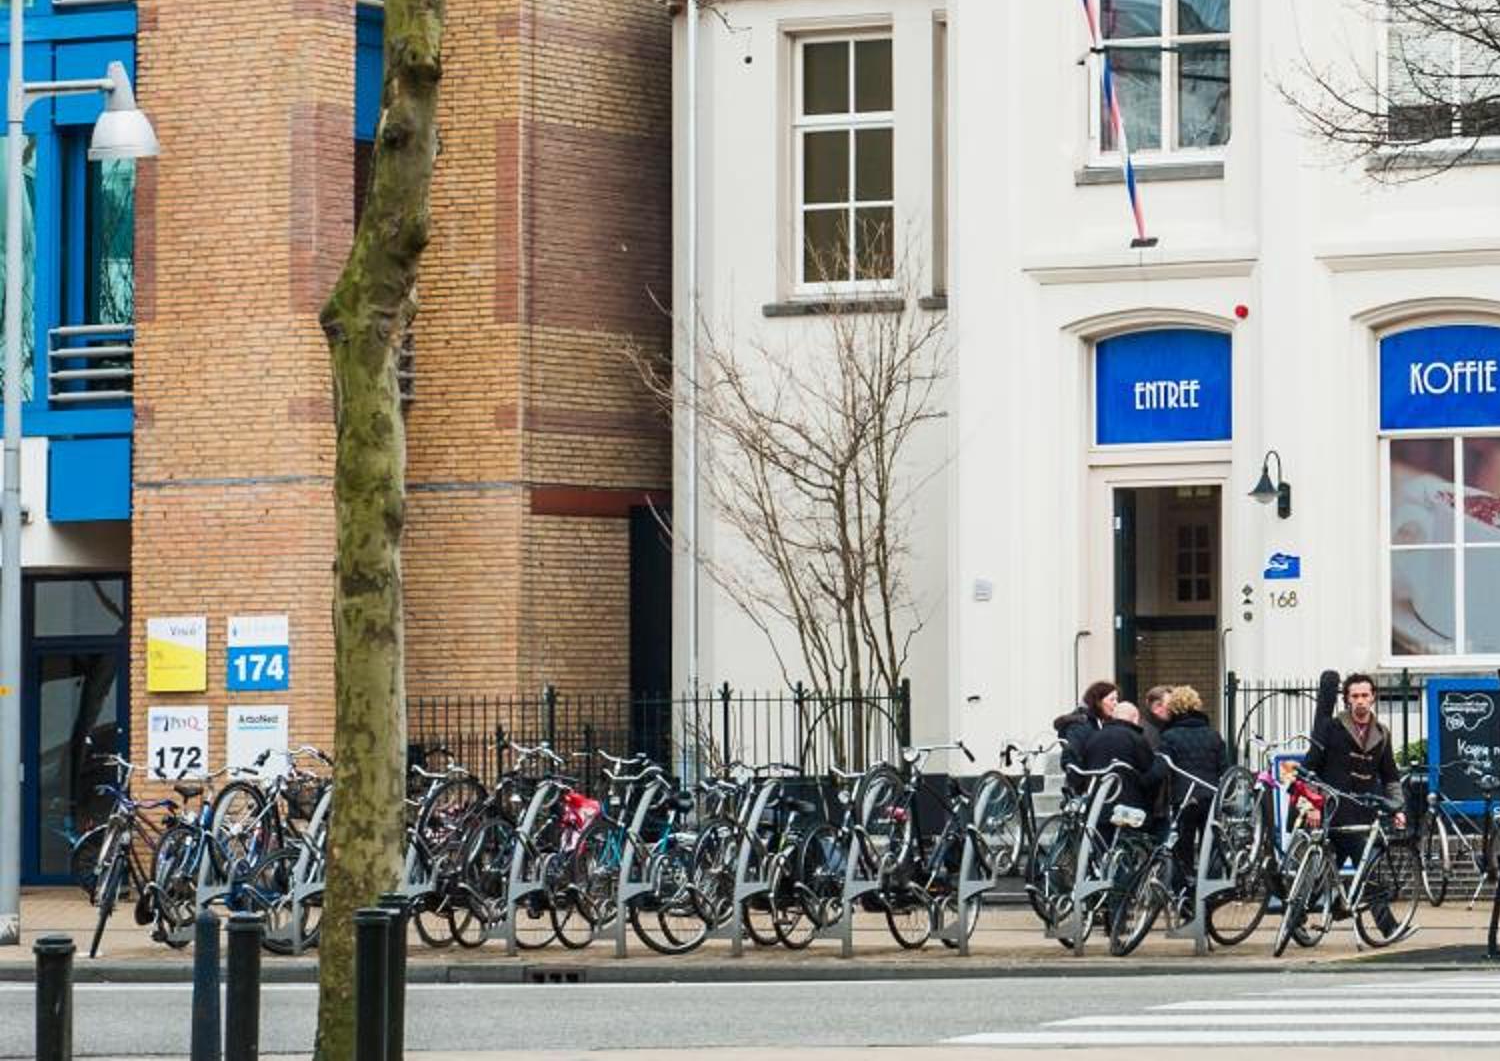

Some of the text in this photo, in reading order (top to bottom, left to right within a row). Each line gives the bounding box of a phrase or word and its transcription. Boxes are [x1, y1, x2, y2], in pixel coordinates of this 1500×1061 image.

[1410, 360, 1497, 395] KOFFIE
[1135, 380, 1200, 409] ENTREE
[1269, 590, 1297, 608] 168
[233, 654, 284, 682] 174
[156, 746, 202, 769] 172
